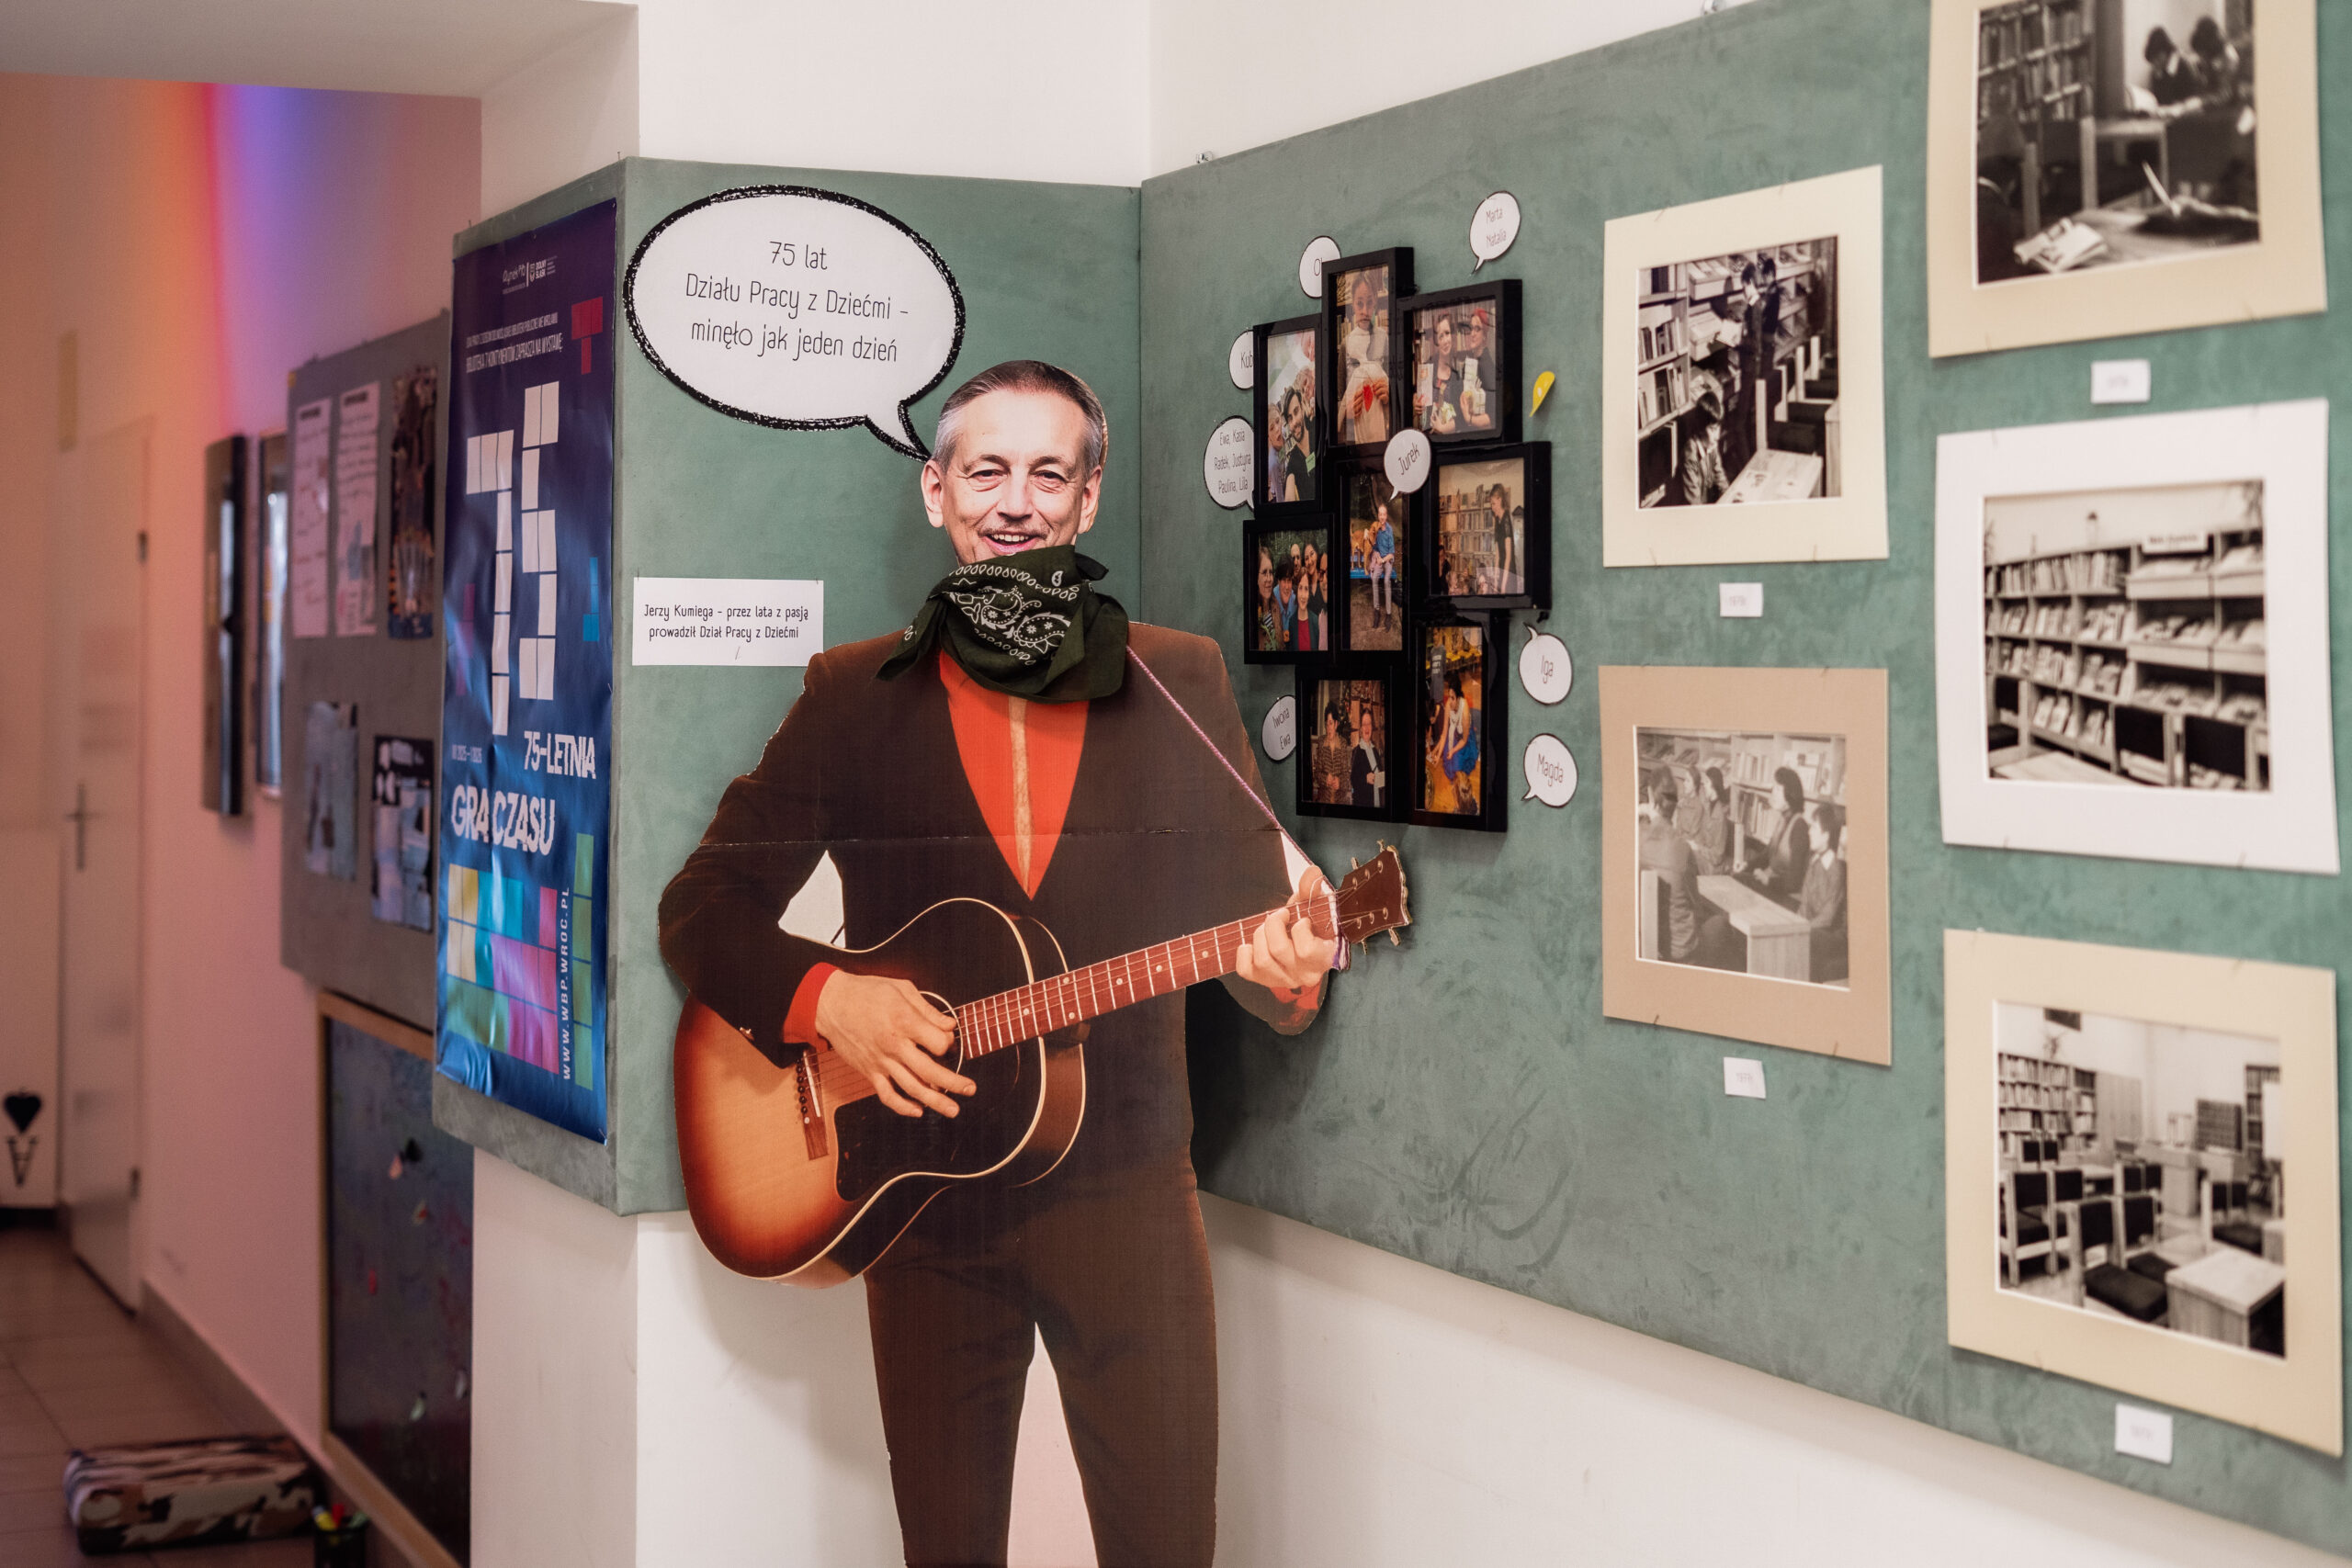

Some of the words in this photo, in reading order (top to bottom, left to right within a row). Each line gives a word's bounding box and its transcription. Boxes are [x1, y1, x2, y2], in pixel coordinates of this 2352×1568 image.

[769, 241, 796, 266] 75
[805, 244, 828, 271] lat
[685, 273, 741, 302] Działu
[750, 280, 800, 320] Pracy
[808, 293, 817, 310] z
[826, 289, 891, 320] Dziećmi
[691, 318, 753, 349] minęło
[757, 324, 788, 358] jak
[793, 328, 843, 361] jeden
[853, 331, 898, 362] dzień
[1233, 428, 1245, 443] Kasia
[1232, 453, 1251, 472] Justyna
[1398, 442, 1419, 475] Jurek
[644, 604, 670, 621] Jerzy
[674, 604, 714, 622] Kumiega
[727, 607, 751, 621] przez
[755, 605, 773, 617] lata
[776, 609, 781, 617] z
[786, 606, 808, 622] pasją
[649, 626, 696, 641] prowadził
[699, 626, 722, 638] Dział
[726, 626, 752, 643] Pracy
[756, 629, 761, 638] z
[764, 626, 798, 638] Dziećmi
[1541, 655, 1554, 683] Iga
[524, 730, 596, 779] 75-LETNIA
[1280, 734, 1291, 750] Ewa
[1537, 753, 1564, 787] Magda
[451, 784, 490, 843] GRA
[492, 790, 555, 856] CZASU
[560, 887, 571, 1079] WWW.WBP.WROC.PL
